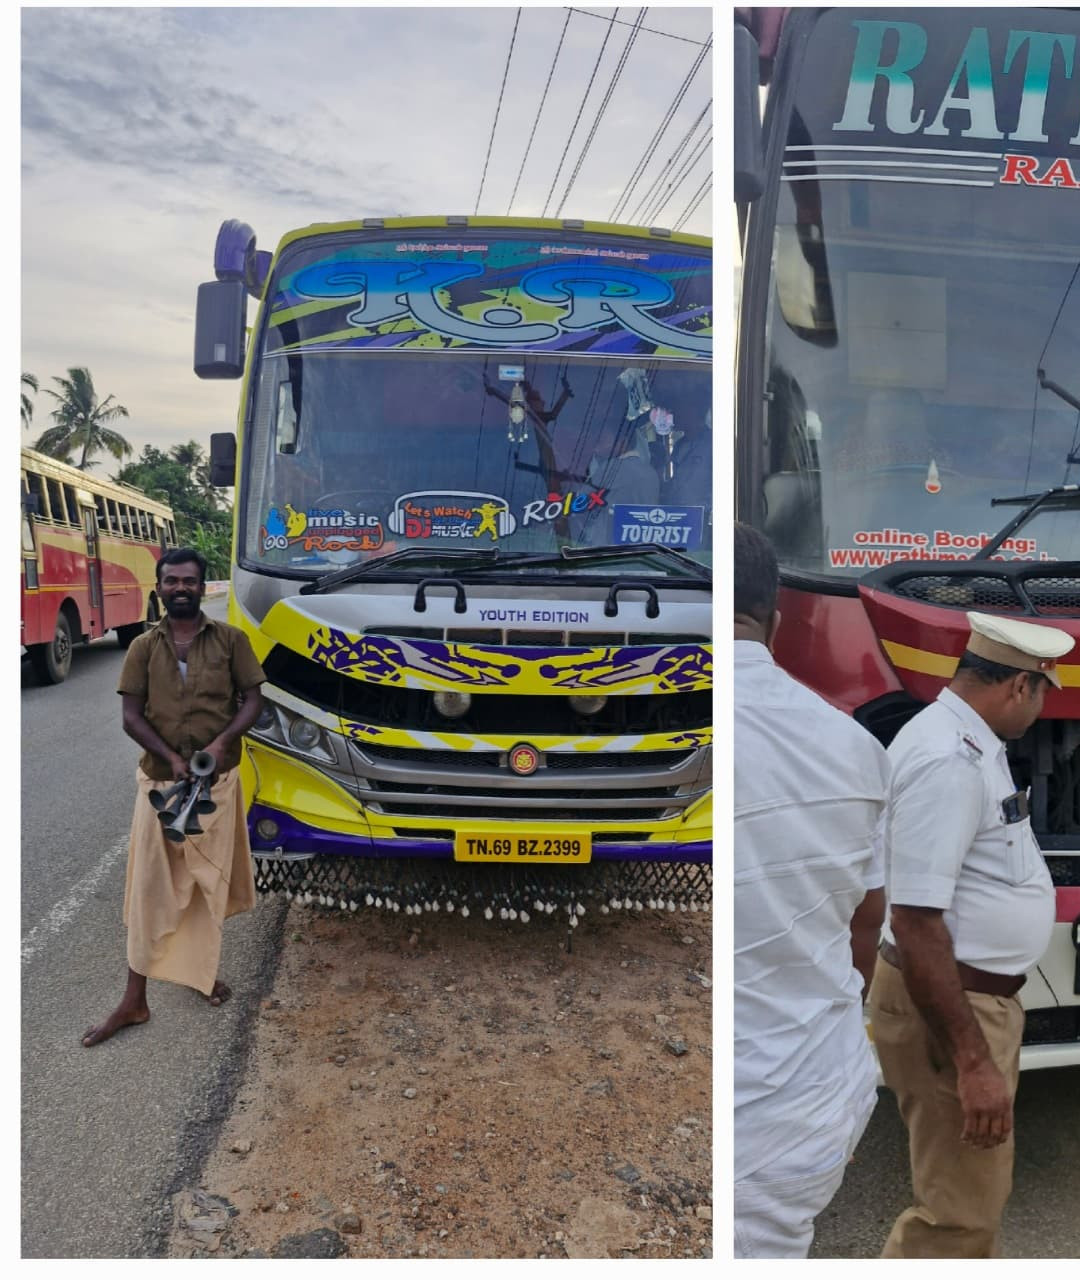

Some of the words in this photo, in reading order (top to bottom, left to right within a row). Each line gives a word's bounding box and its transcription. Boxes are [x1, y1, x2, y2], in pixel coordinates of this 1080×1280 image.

[308, 513, 379, 527] music
[433, 506, 473, 520] Watch
[620, 524, 692, 544] TOURIST
[854, 529, 929, 545] online
[303, 535, 383, 551] Rock
[479, 609, 527, 622] YOUTH
[532, 610, 589, 623] EDITION
[466, 839, 512, 856] TN.69
[517, 839, 581, 856] BZ.2399
